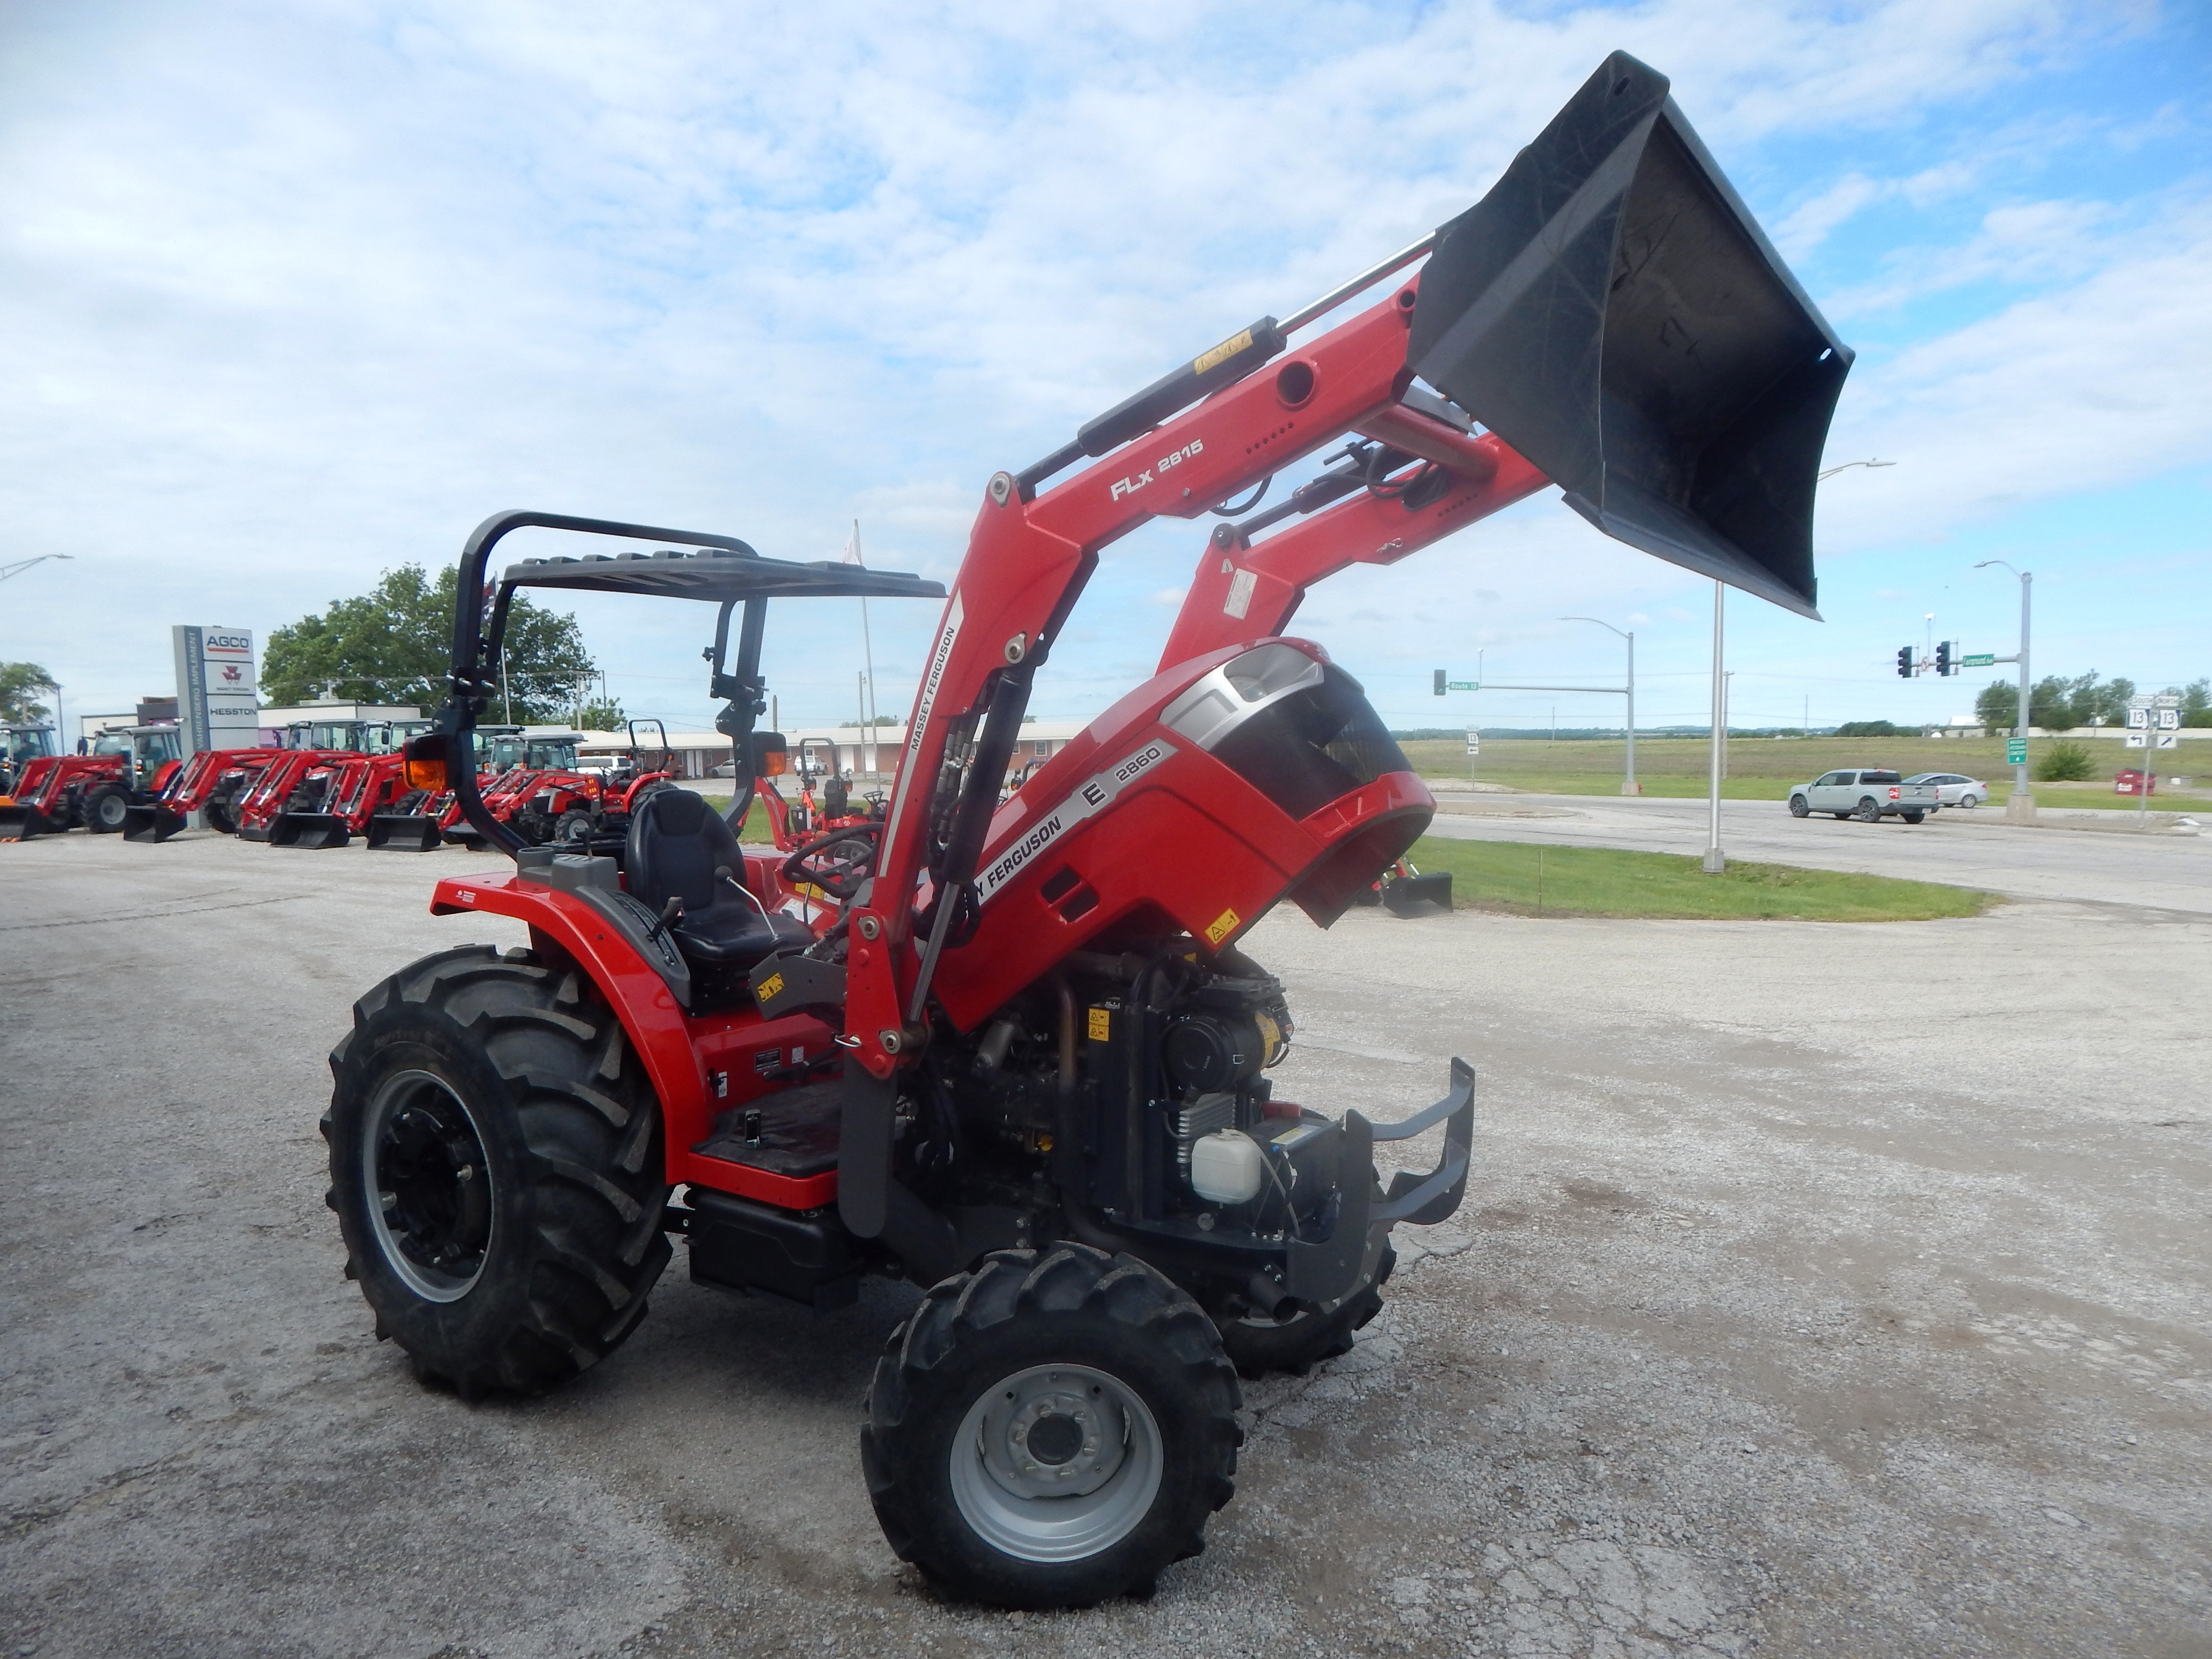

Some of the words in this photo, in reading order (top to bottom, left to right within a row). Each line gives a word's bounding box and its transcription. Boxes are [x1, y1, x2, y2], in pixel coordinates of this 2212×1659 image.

[1157, 439, 1203, 473] 2815
[189, 632, 200, 685] IMPLEMENT
[206, 636, 249, 648] AGCO
[911, 697, 931, 750] MASSEY
[927, 626, 954, 695] FERGUSON
[2133, 712, 2144, 723] 13
[2164, 713, 2174, 724] 13
[987, 815, 1062, 888] FERGUSON
[1082, 783, 1106, 806] E
[1116, 747, 1161, 782] 2860
